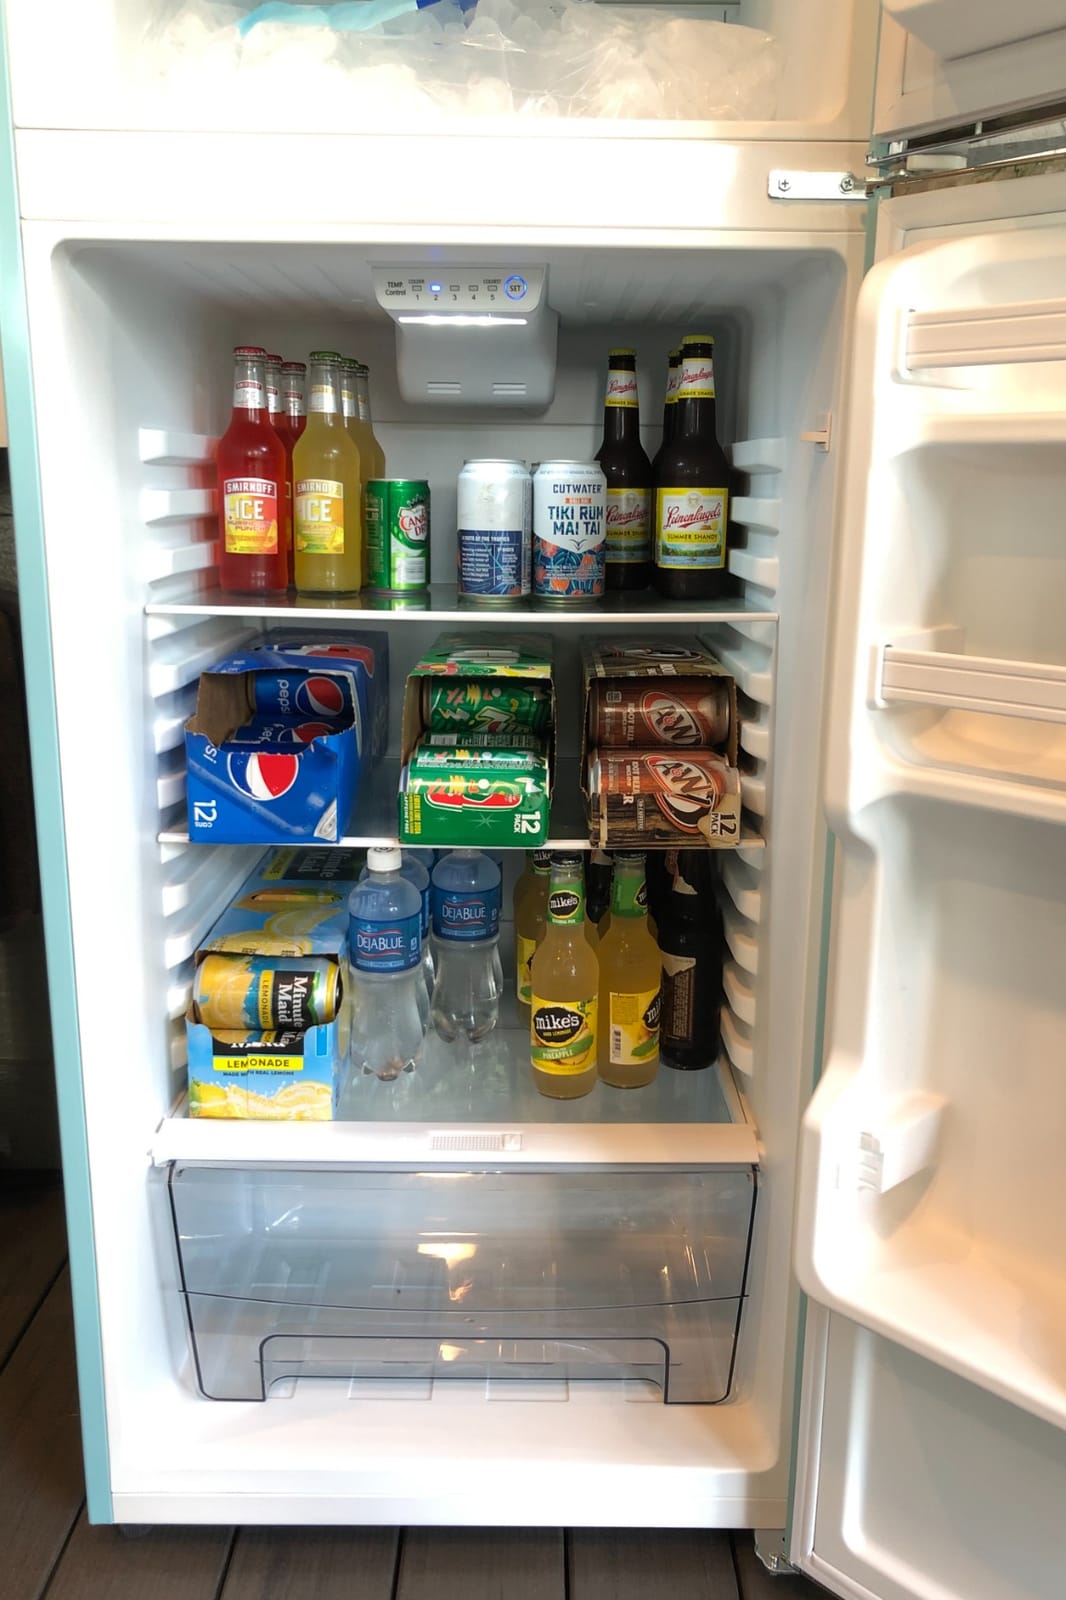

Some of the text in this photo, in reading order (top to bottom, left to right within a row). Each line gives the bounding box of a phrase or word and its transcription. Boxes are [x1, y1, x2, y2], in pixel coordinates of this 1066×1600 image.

[226, 481, 273, 494] SMIRNOFF
[296, 482, 339, 494] SMIRNOFF
[552, 484, 602, 494] CUTWATER
[235, 500, 265, 521] ICE
[302, 499, 332, 522] ICE
[547, 506, 575, 520] TIKI
[553, 521, 600, 536] MAI TAI
[277, 679, 290, 712] peps
[193, 799, 218, 822] 12
[513, 813, 521, 834] PACK
[521, 811, 541, 834] 12
[711, 812, 720, 836] PACK
[719, 813, 737, 836] 12
[550, 895, 578, 909] mike's
[261, 979, 270, 1024] LEMONADE
[277, 983, 293, 1023] Maid
[292, 975, 309, 1028] Minute
[535, 1013, 580, 1030] mike's
[226, 1058, 290, 1069] LEMONADE
[542, 1049, 573, 1060] PINEAPPLE
